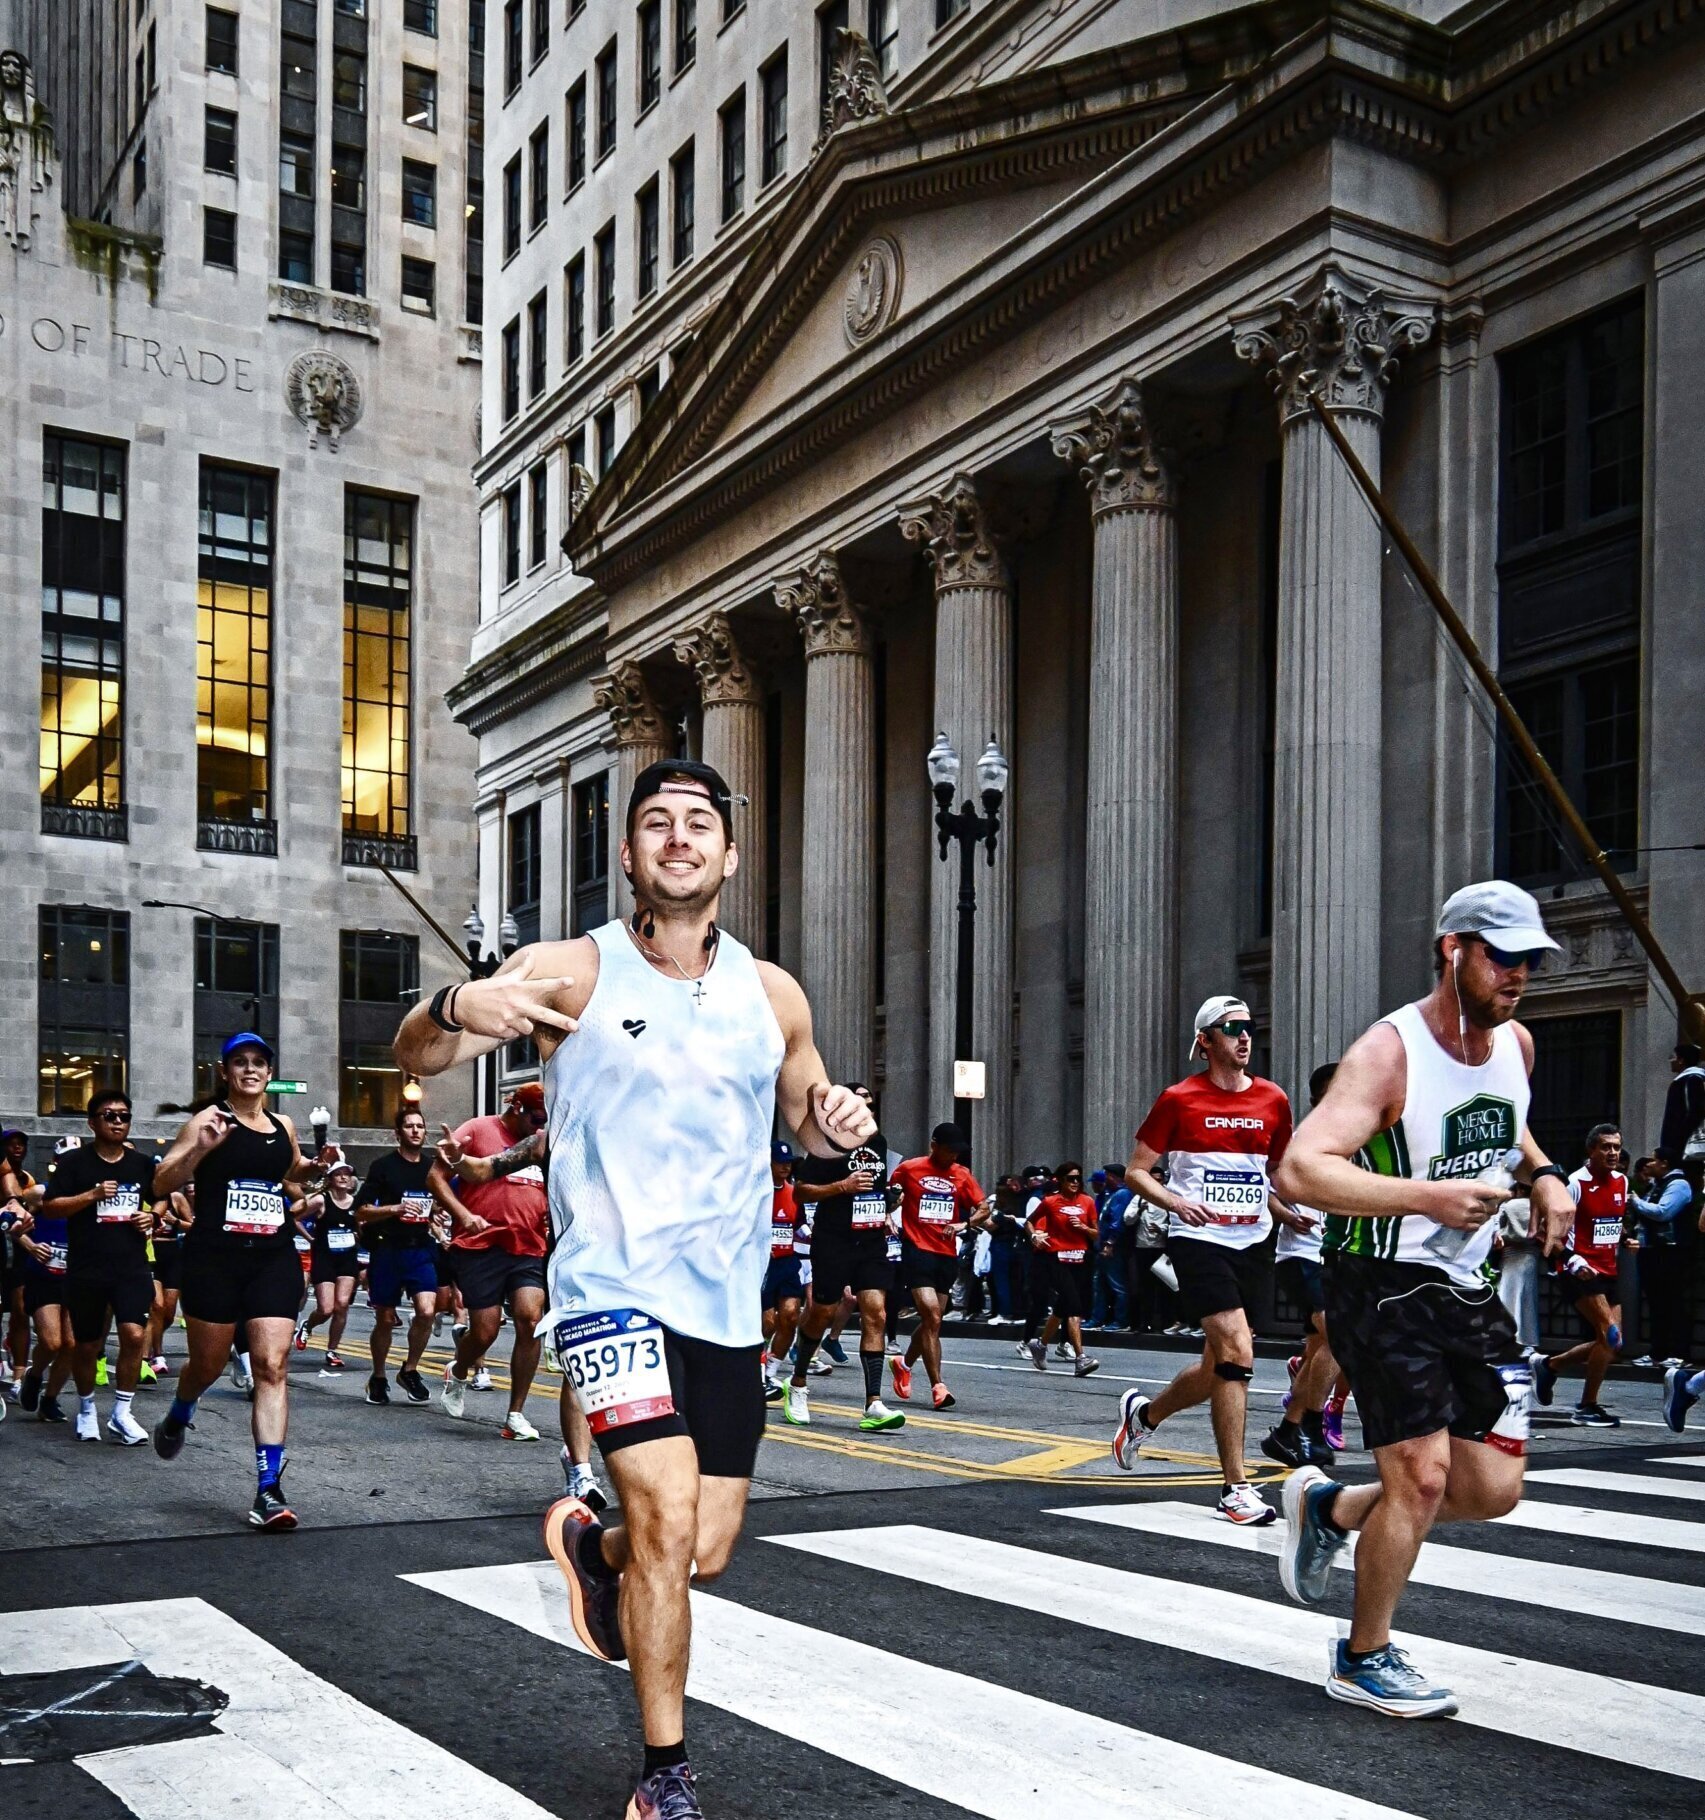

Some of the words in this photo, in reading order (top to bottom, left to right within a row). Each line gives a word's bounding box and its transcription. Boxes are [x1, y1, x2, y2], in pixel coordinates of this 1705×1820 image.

[31, 318, 91, 357] OF
[112, 332, 253, 392] TRADE
[1204, 1116, 1264, 1131] CANADA
[1457, 1107, 1506, 1131] MERCY
[1458, 1122, 1508, 1146] HOME
[847, 1159, 886, 1173] Chicago
[1434, 1148, 1509, 1178] HEROE
[228, 1193, 283, 1215] H35098
[1205, 1186, 1263, 1204] H26269
[920, 1201, 953, 1213] H47119
[583, 1322, 617, 1337] MARATHON
[561, 1338, 660, 1389] H35973
